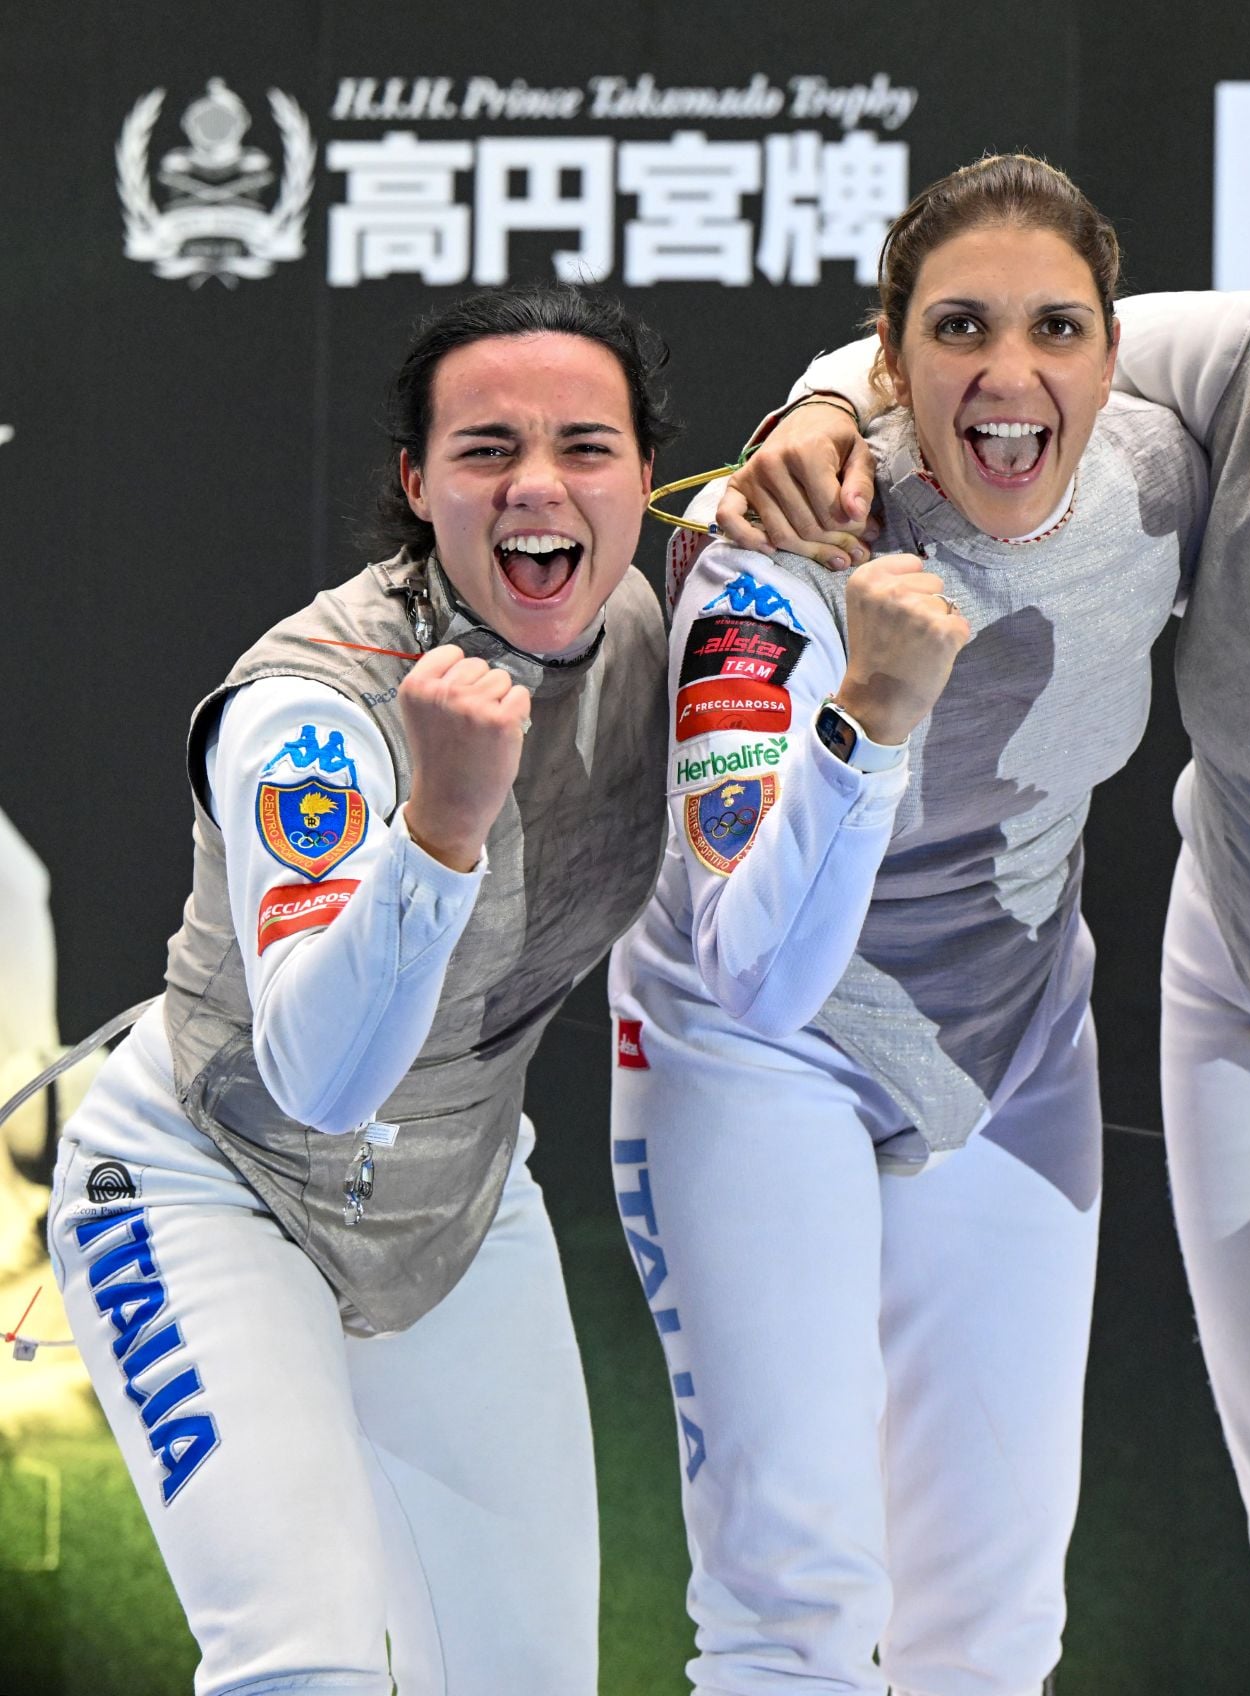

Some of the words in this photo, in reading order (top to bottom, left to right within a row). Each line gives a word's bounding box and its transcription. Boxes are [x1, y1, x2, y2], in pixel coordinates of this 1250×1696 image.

[461, 75, 584, 120] Prince
[588, 72, 784, 119] Takamado
[788, 72, 918, 130] Trophy
[326, 131, 909, 288] 高円宮牌
[701, 627, 787, 660] allstar
[726, 660, 772, 678] TEAM
[696, 699, 786, 712] FRECCIAROSSA
[677, 743, 780, 785] Herbalife
[264, 793, 279, 837] CENTRO
[274, 838, 313, 868] SPORTIVO
[697, 836, 730, 870] SPORTIVO
[75, 1207, 222, 1508] ITALIA
